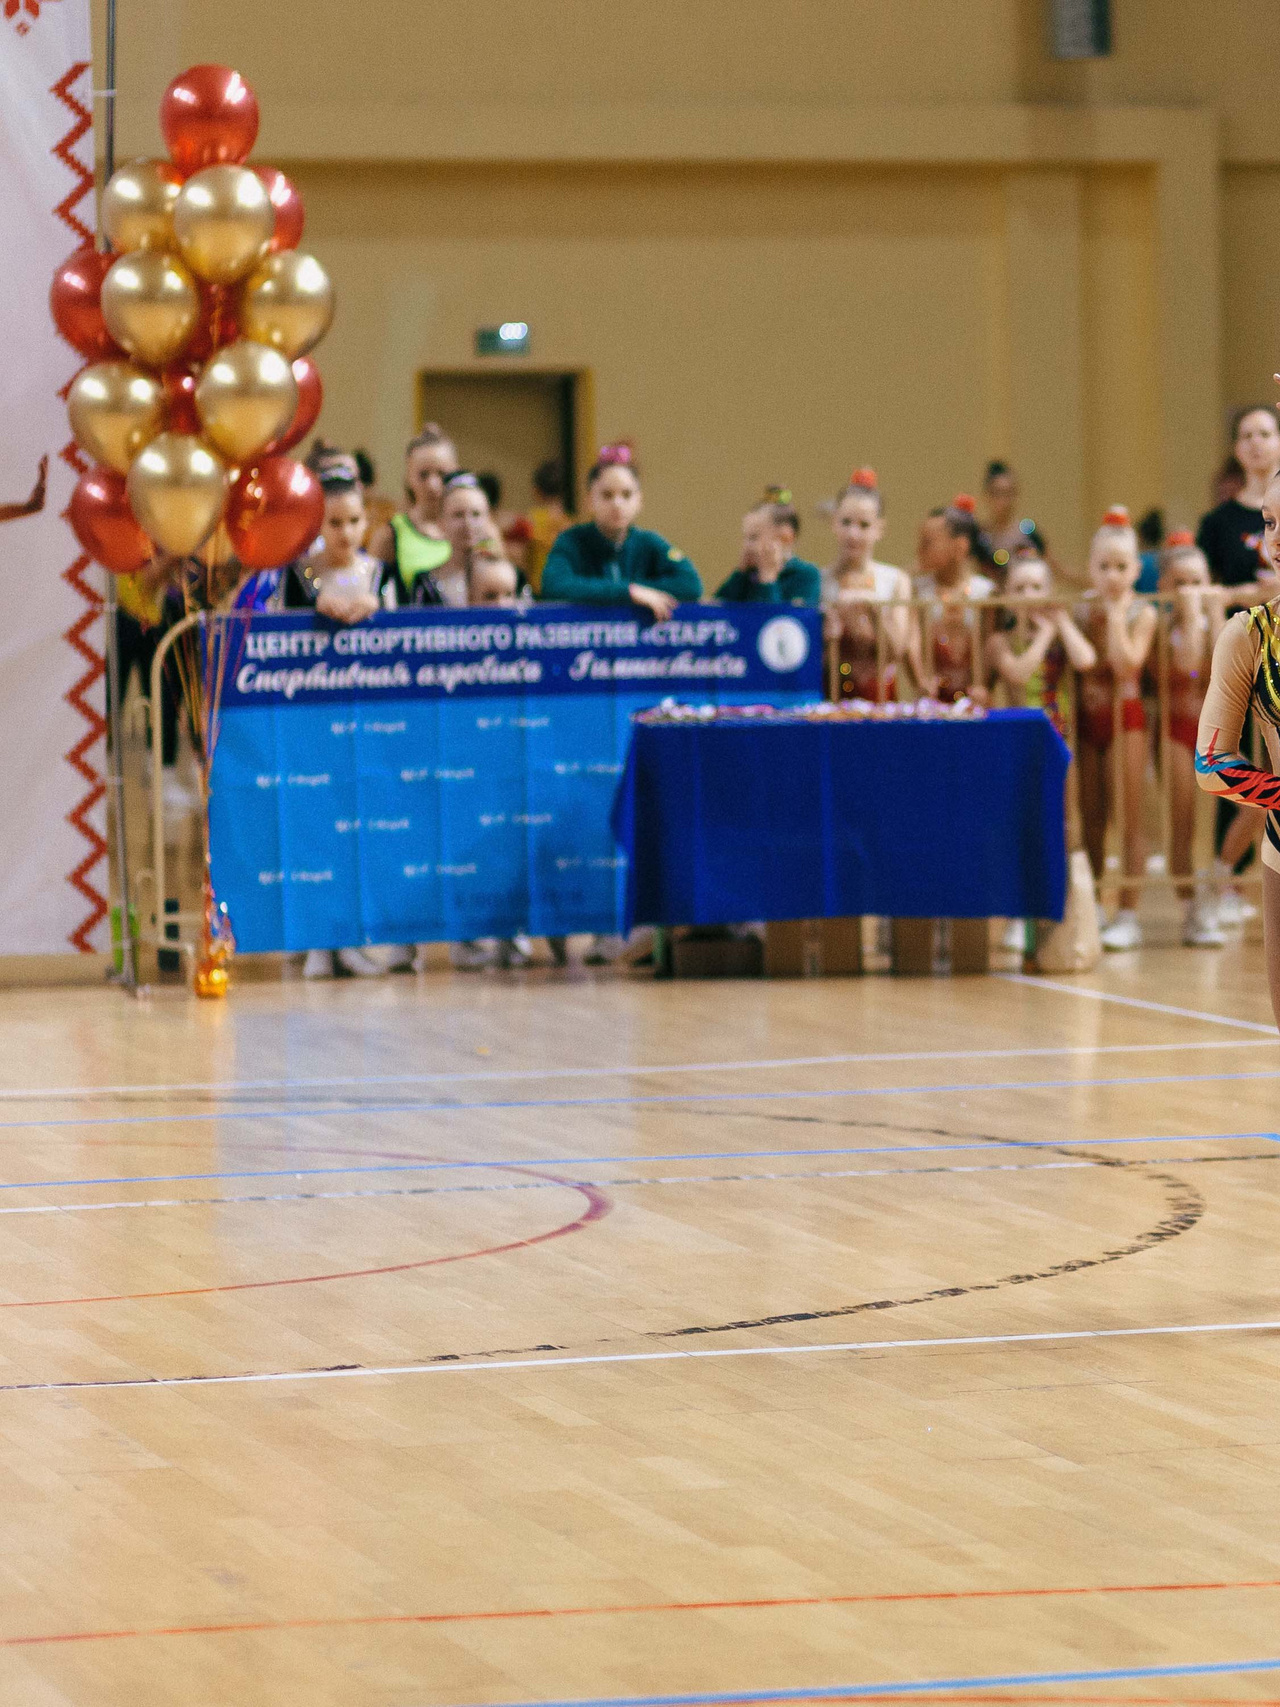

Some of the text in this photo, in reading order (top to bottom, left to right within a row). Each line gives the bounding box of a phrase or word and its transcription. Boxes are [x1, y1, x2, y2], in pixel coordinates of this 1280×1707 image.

[247, 630, 329, 660] ЦЕНТР
[333, 624, 513, 654] СПОРТИВНОГО
[515, 621, 638, 649] РАЗВИТИЯ
[236, 661, 410, 699] Спортивная
[569, 651, 747, 681] Гимнастика
